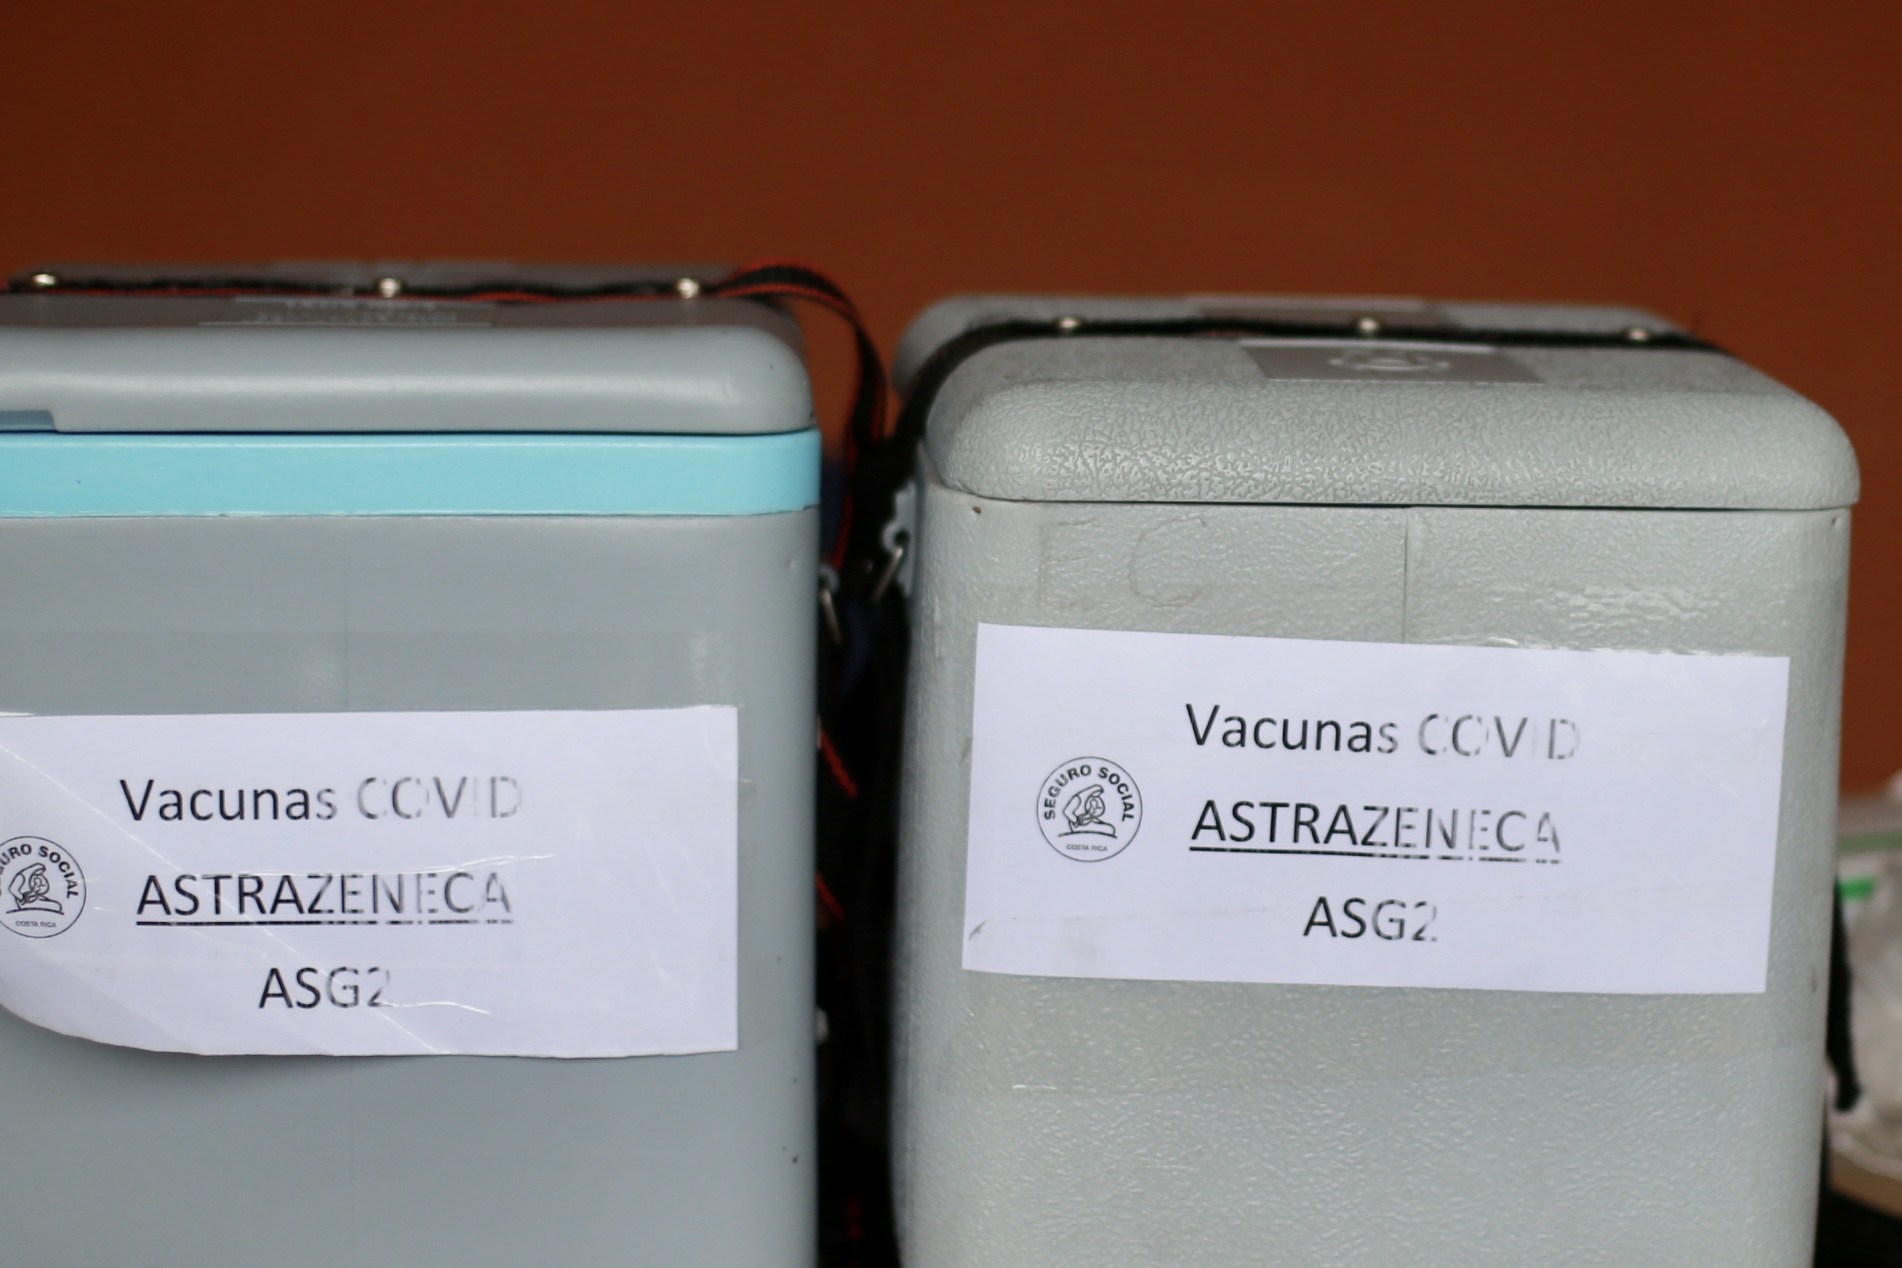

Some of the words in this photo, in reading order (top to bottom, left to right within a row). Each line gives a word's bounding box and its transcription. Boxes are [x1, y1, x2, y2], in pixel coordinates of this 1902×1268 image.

[1185, 702, 1398, 754] Vacunas
[119, 778, 338, 822] Vacunas
[356, 775, 523, 821] COVID
[1044, 764, 1092, 821] SEGURO
[1097, 766, 1135, 822] SOCIAL
[1188, 798, 1561, 862] ASTRAZENECA
[38, 845, 79, 899] SOCIAL
[135, 871, 514, 924] ASTRAZENECA
[1301, 895, 1438, 943] ASG2
[258, 965, 393, 1010] ASG2
